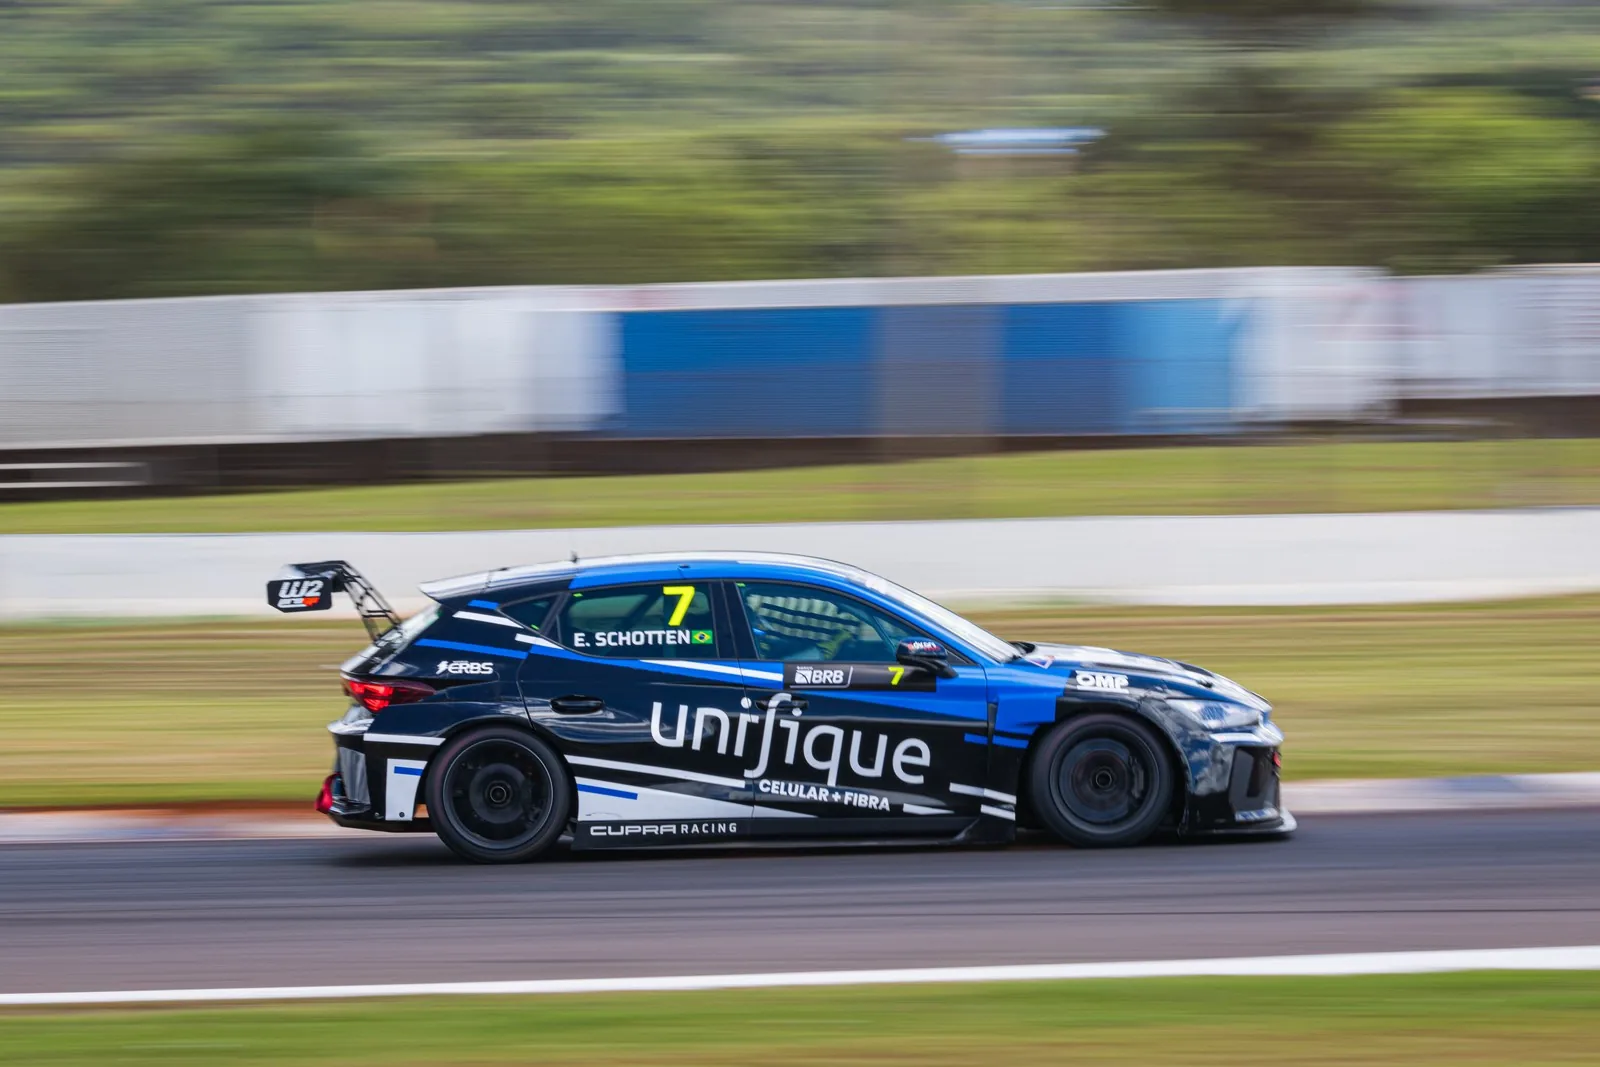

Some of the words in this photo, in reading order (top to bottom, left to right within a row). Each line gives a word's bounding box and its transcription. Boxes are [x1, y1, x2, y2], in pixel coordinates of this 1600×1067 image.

[278, 580, 324, 598] W2
[662, 585, 696, 627] 7
[573, 632, 591, 648] E.
[595, 629, 690, 647] SCHOTTEN
[811, 669, 844, 684] BRB
[888, 666, 905, 686] 7
[1075, 673, 1129, 689] OMP
[650, 692, 931, 787] unifique
[758, 779, 828, 803] CELULAR
[845, 791, 890, 812] FIBRA
[590, 824, 676, 836] CUPRA
[681, 822, 737, 834] RACING
